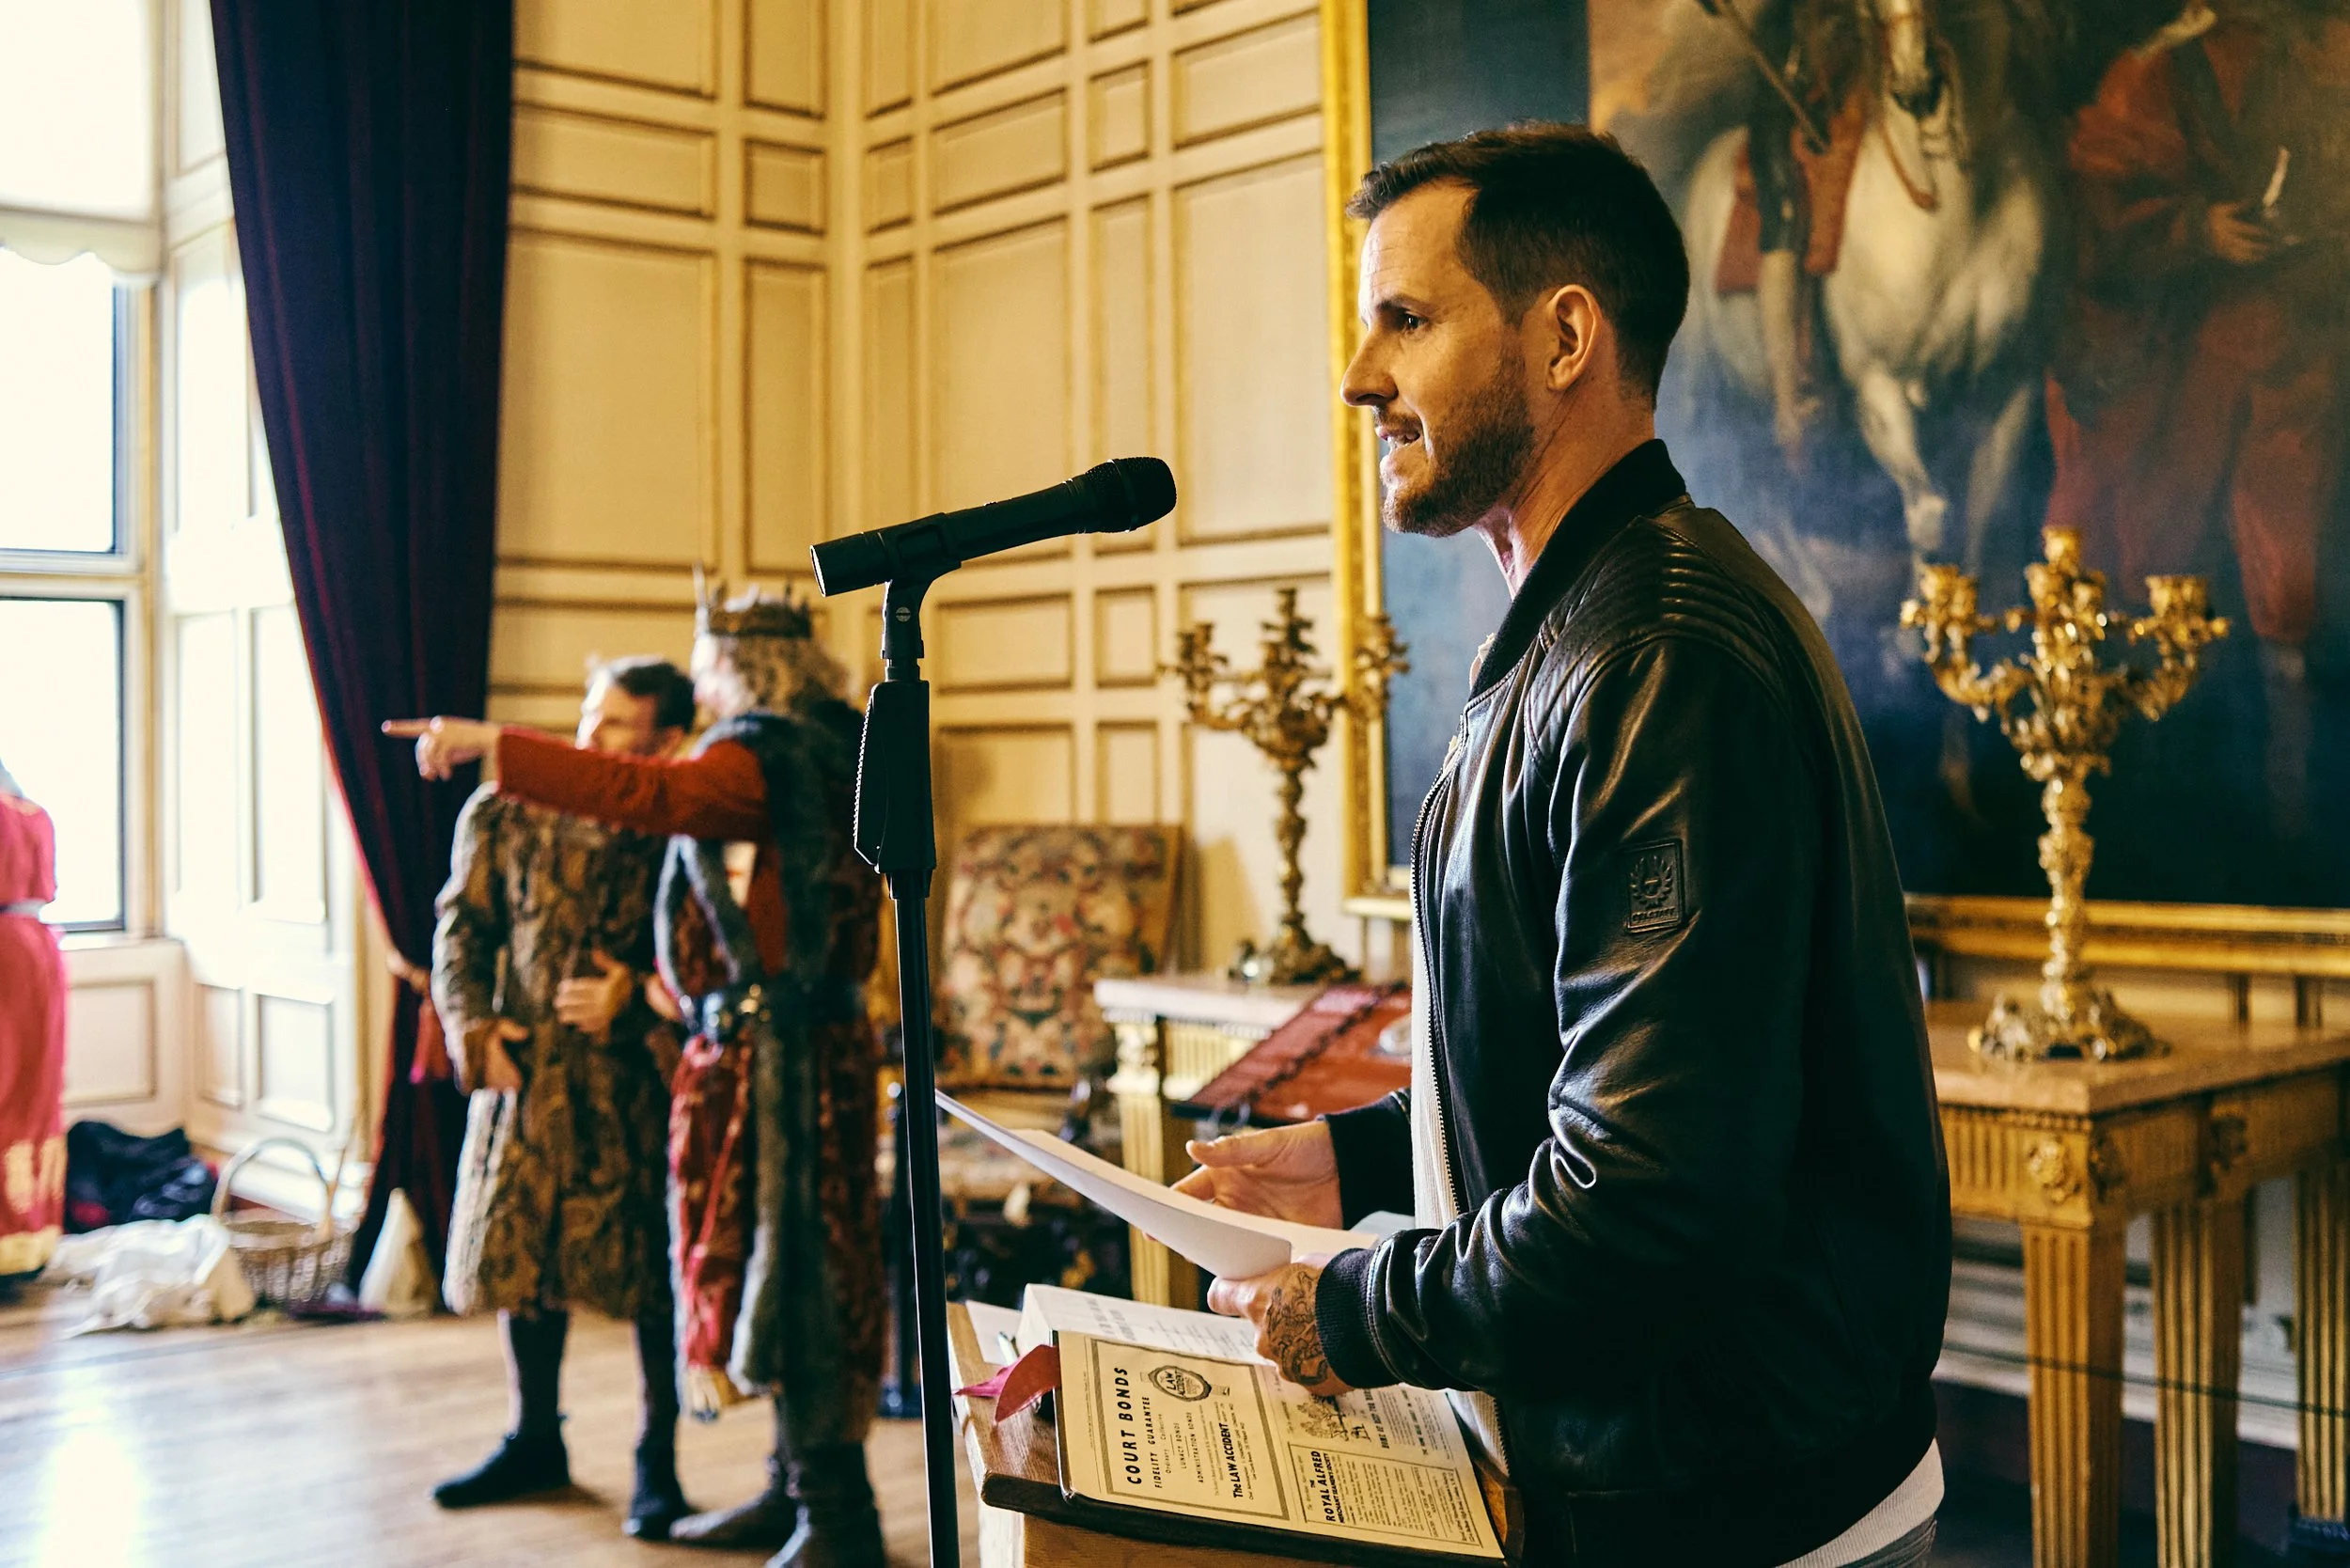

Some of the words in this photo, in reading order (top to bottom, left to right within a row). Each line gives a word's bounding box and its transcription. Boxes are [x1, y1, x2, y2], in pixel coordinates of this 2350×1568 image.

[1114, 1367, 1134, 1421] BONDS
[1165, 1371, 1177, 1390] LAW
[1141, 1397, 1155, 1445] GUARANTEE
[1173, 1423, 1183, 1442] BONDS
[1120, 1430, 1142, 1484] COURT
[1177, 1446, 1187, 1469] LUNACY
[1190, 1434, 1204, 1483] ADMINISTRATION
[1218, 1422, 1236, 1462] ACCIDENT
[1150, 1452, 1163, 1488] FIDELITY
[1227, 1462, 1241, 1482] LAW
[1310, 1450, 1327, 1486] ALFRED
[1232, 1483, 1244, 1498] The
[1320, 1489, 1336, 1522] ROYAL
[1333, 1496, 1344, 1523] MERCHANT
